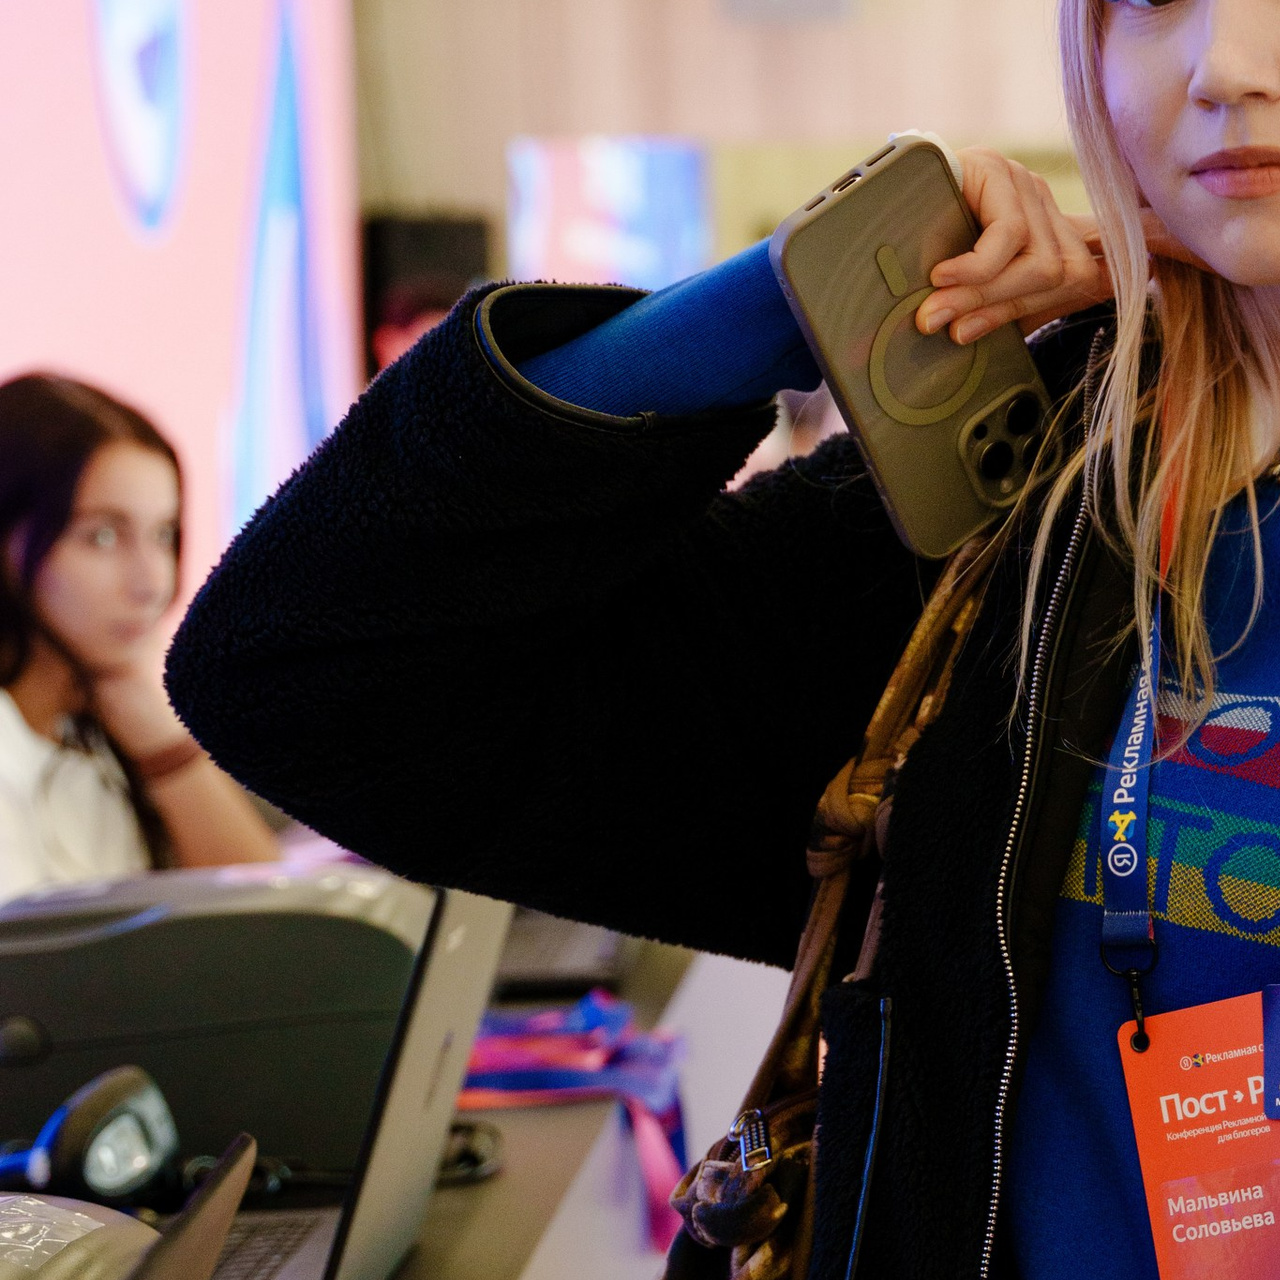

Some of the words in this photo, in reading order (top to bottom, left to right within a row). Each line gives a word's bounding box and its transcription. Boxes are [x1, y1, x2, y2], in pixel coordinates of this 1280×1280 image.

[1112, 676, 1150, 804] Рекламная
[1205, 1044, 1257, 1064] Рекламная
[1159, 1089, 1228, 1124] Пост
[1166, 1123, 1222, 1141] Конференция
[1217, 1133, 1233, 1144] для
[1233, 1125, 1271, 1138] блогеров
[1167, 1184, 1264, 1216] Мальвина
[1172, 1210, 1276, 1243] Соловьева
